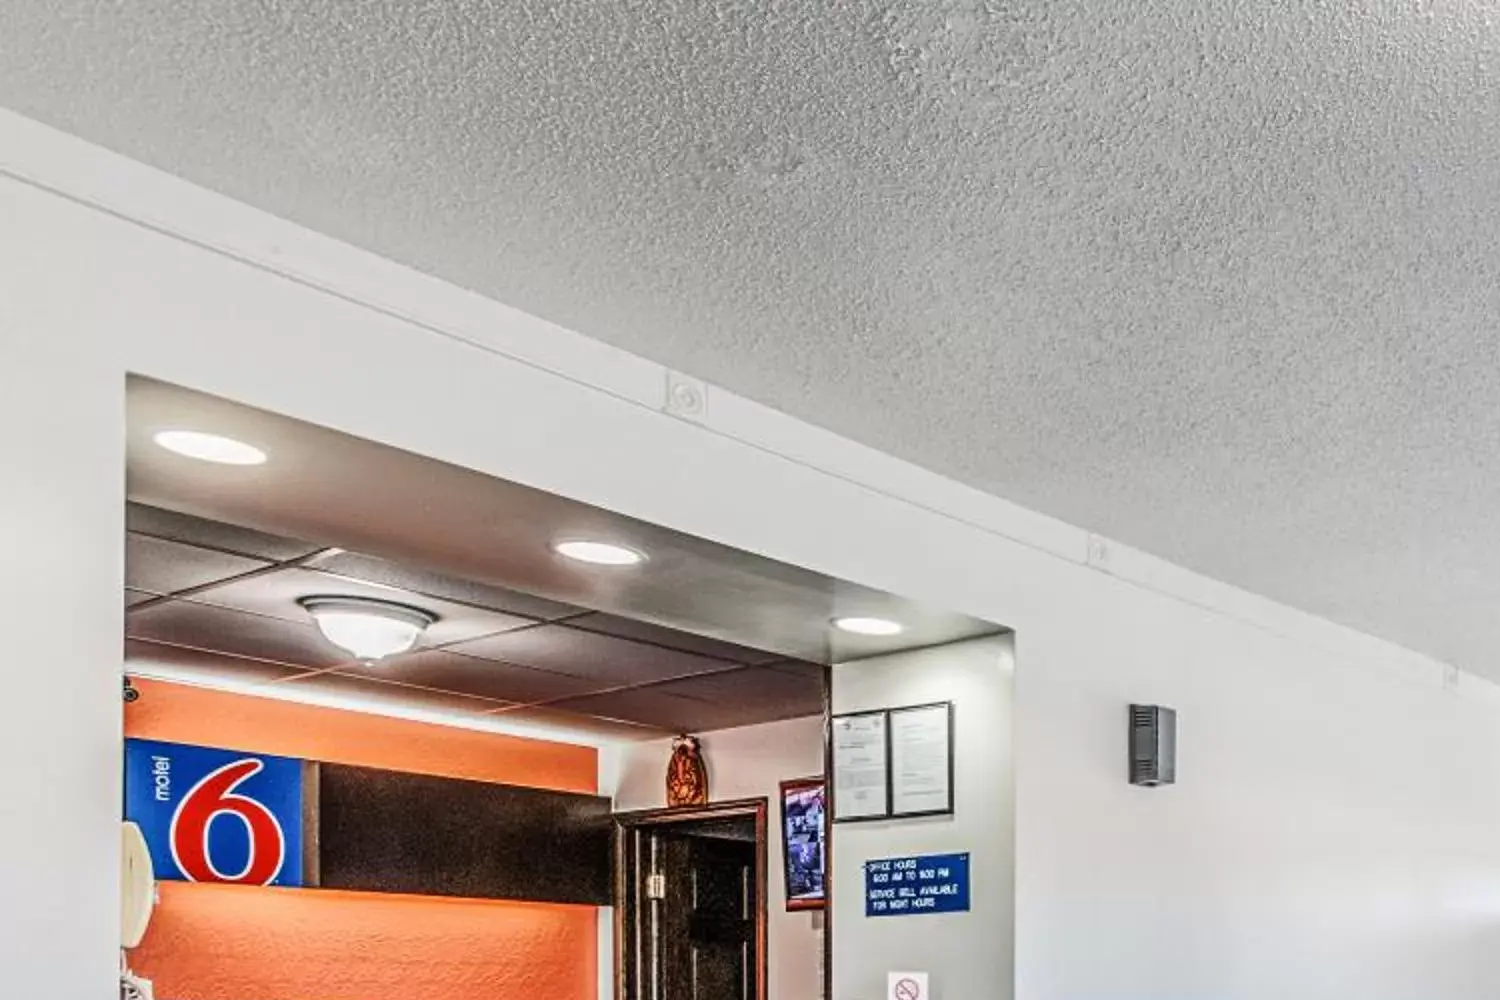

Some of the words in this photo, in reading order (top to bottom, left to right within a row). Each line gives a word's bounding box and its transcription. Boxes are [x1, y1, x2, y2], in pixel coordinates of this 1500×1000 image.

[151, 755, 172, 801] motel
[169, 757, 285, 887] 6
[893, 859, 917, 870] HOURS
[892, 871, 903, 881] AM
[906, 870, 916, 880] TO
[937, 867, 949, 877] PM
[869, 888, 895, 899] SERVICE
[899, 887, 916, 897] BELL
[919, 883, 959, 896] AVAILABLE
[873, 901, 887, 911] FOR
[890, 899, 909, 910] NIGHT
[912, 897, 935, 908] HOURS
